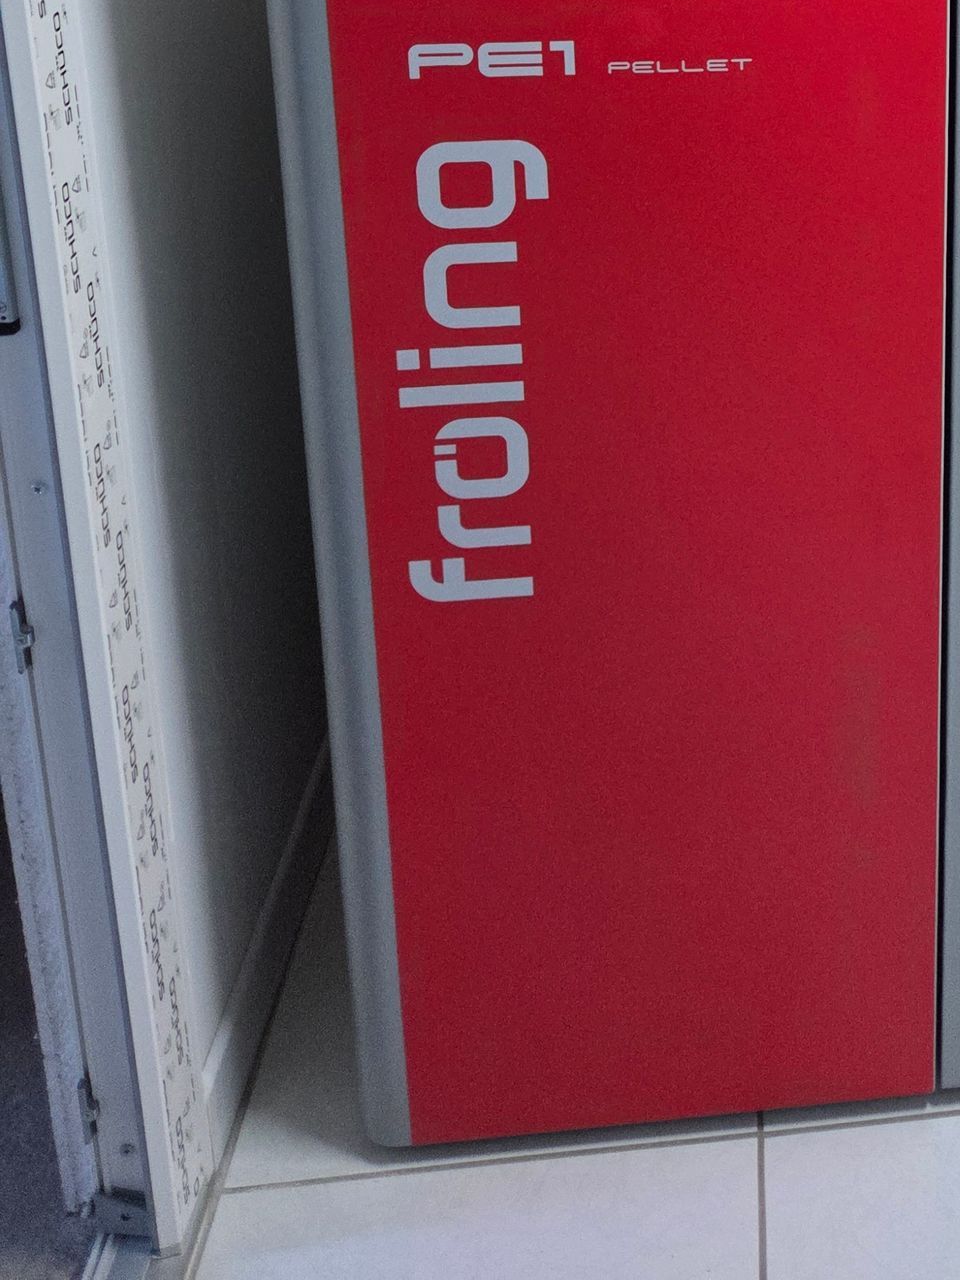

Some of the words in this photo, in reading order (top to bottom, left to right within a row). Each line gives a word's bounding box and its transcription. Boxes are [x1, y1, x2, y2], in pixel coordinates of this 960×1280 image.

[53, 11, 73, 125] SCHÜCO
[408, 40, 576, 80] PE1
[607, 57, 753, 75] PELLET
[62, 182, 81, 294] SCHÜCO
[86, 281, 105, 388] SCHÜCO
